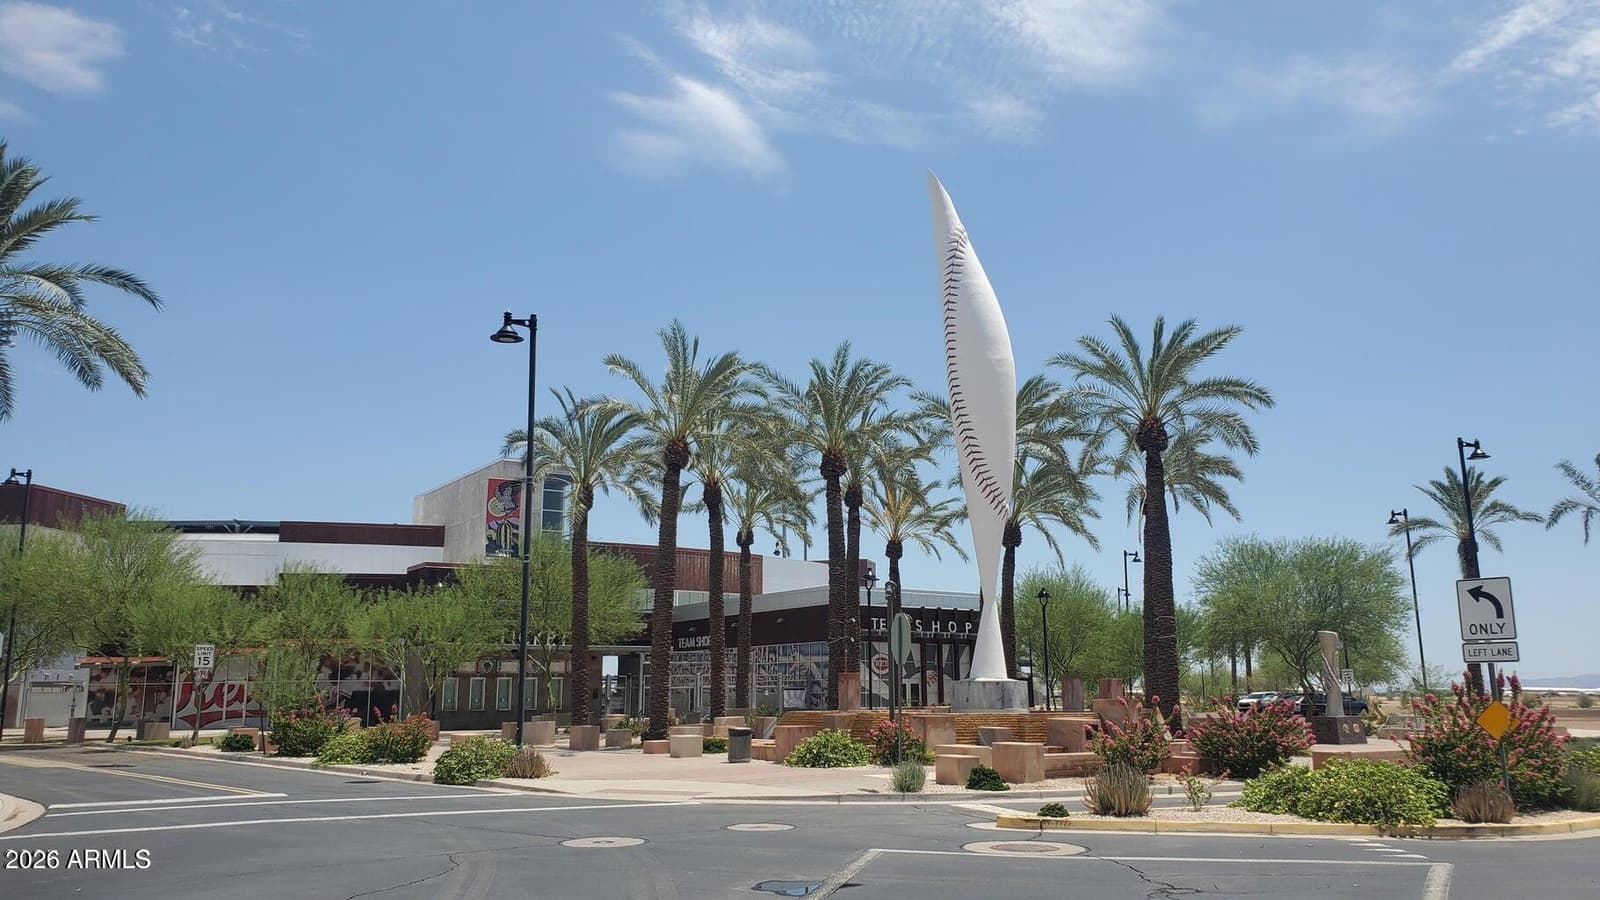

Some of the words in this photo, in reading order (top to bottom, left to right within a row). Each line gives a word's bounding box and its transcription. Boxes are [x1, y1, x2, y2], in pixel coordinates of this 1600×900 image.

[1469, 622, 1506, 636] ONLY
[677, 637, 696, 649] TEAM
[1468, 648, 1487, 657] LEFT
[1490, 647, 1513, 657] LANE
[197, 656, 210, 666] 15
